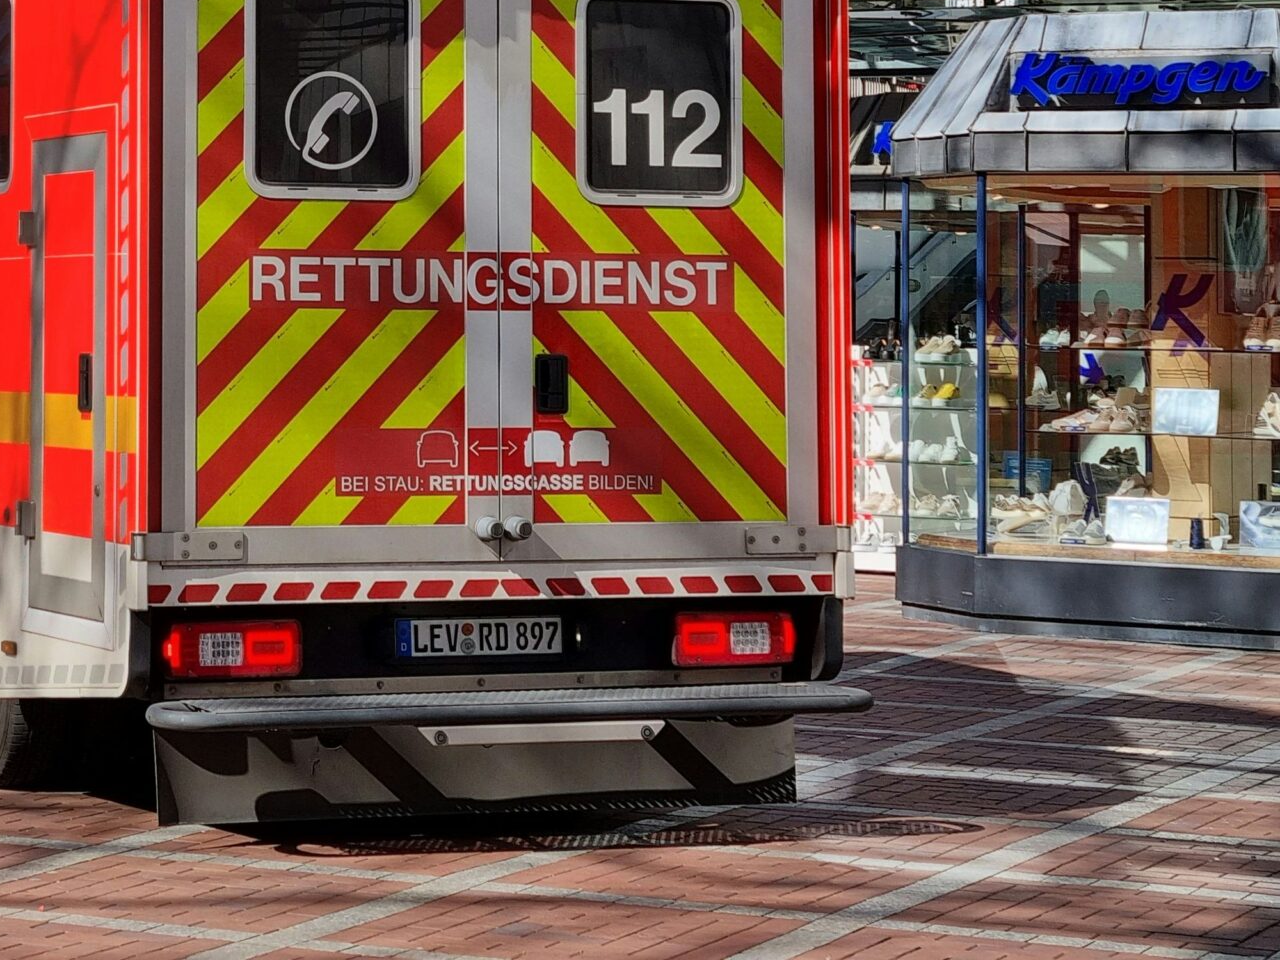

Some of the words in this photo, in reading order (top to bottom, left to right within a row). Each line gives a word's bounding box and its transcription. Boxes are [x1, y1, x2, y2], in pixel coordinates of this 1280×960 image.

[1010, 53, 1265, 107] Kämpgen
[591, 88, 722, 169] 112
[252, 255, 728, 307] RETTUNGSDIENST
[341, 476, 369, 492] BEI
[374, 476, 424, 492] STAU:
[429, 474, 584, 492] RETTUNGSGASSE
[588, 474, 655, 491] BILDEN!
[413, 624, 459, 653] LEV
[479, 622, 509, 652] RD
[515, 621, 559, 651] 897
